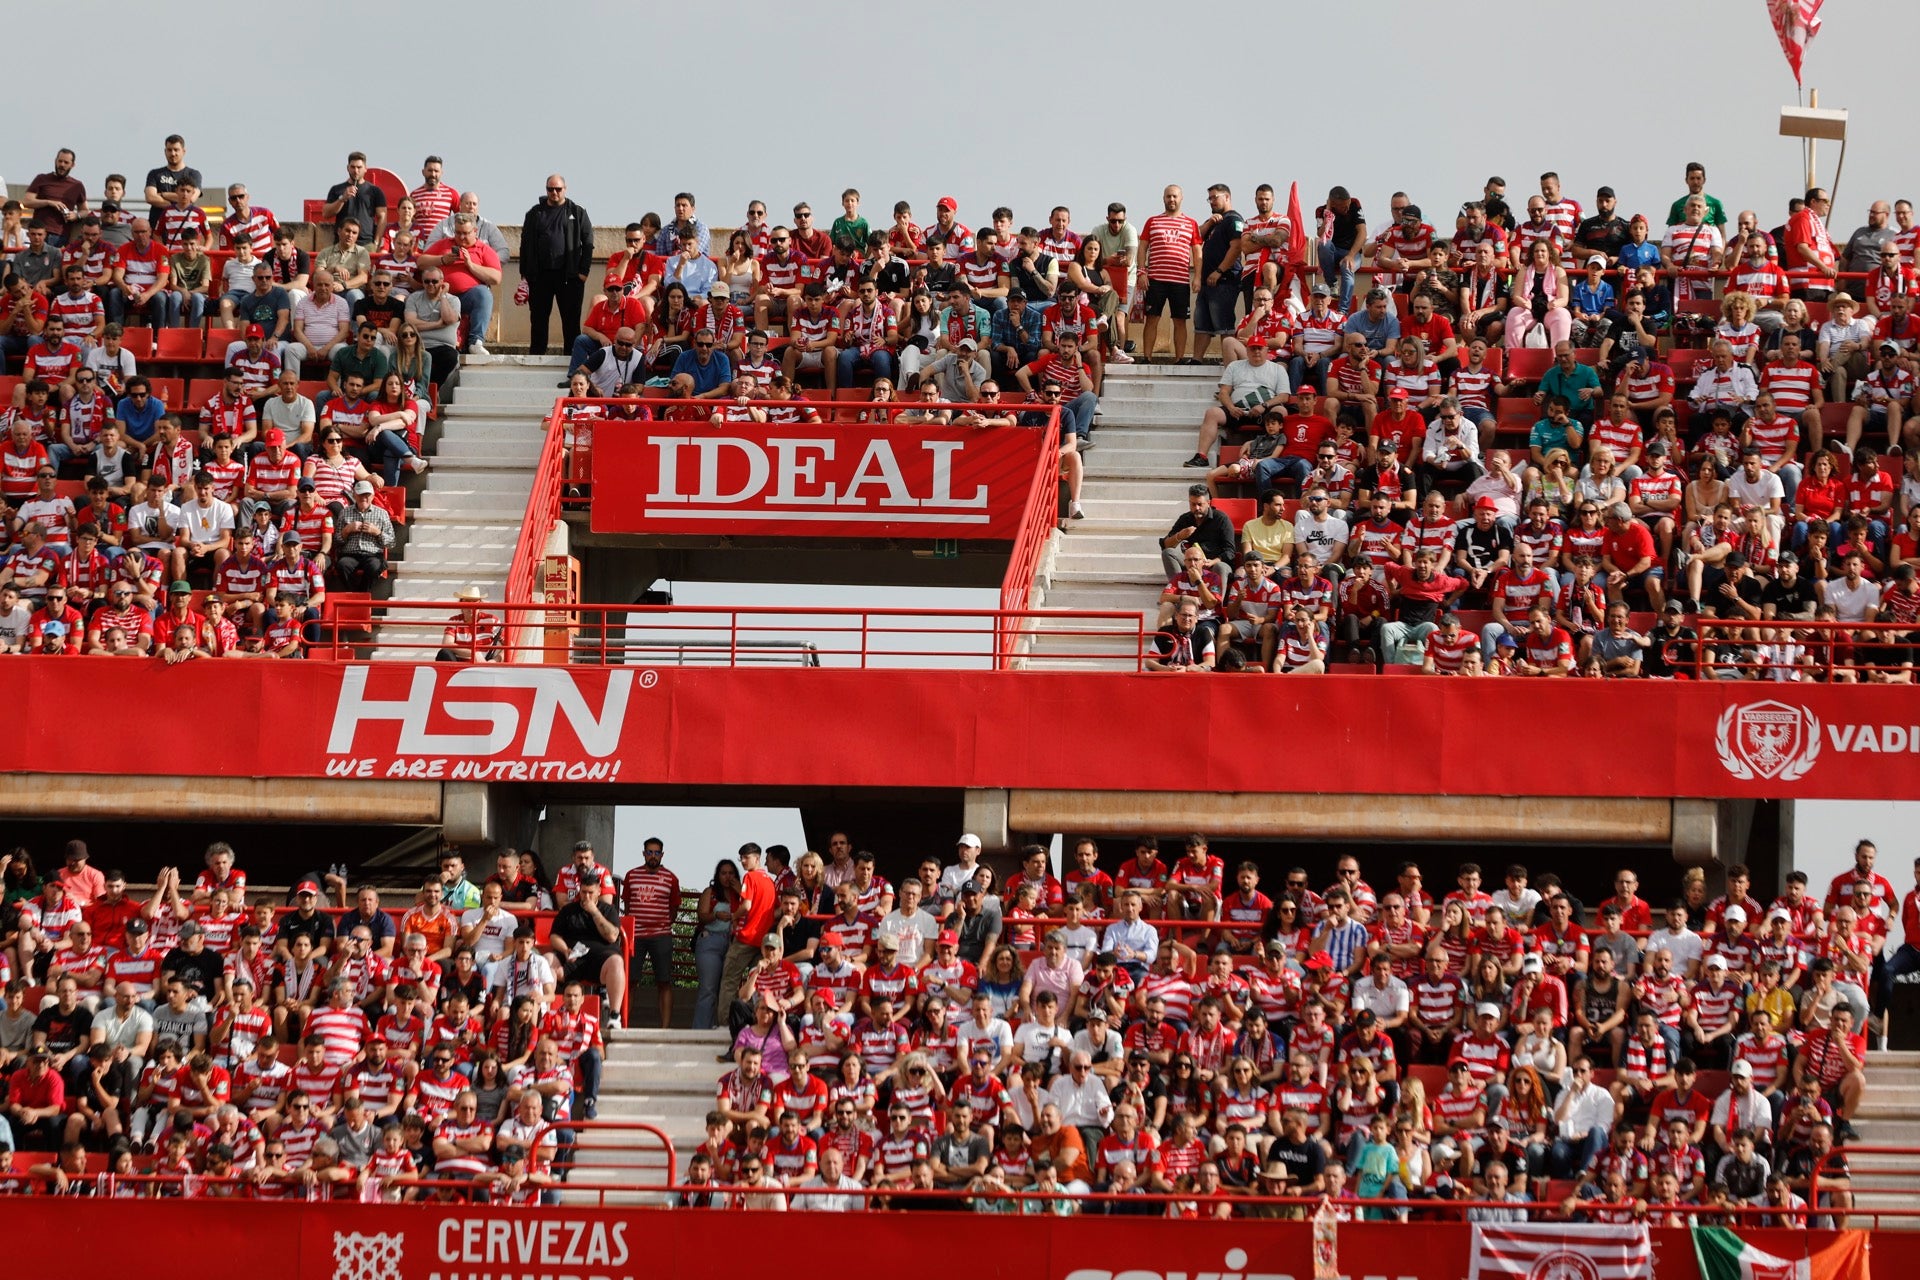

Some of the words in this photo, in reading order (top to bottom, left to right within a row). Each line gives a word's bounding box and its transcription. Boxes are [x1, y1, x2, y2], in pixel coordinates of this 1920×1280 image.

[646, 436, 988, 509] IDEAL
[1309, 530, 1325, 538] JUST
[326, 665, 635, 758] HSN
[1827, 725, 1920, 753] VADI
[325, 758, 378, 778] WE
[386, 758, 448, 778] ARE
[450, 759, 622, 783] NUTRITION!
[437, 1218, 629, 1267] CERVEZAS
